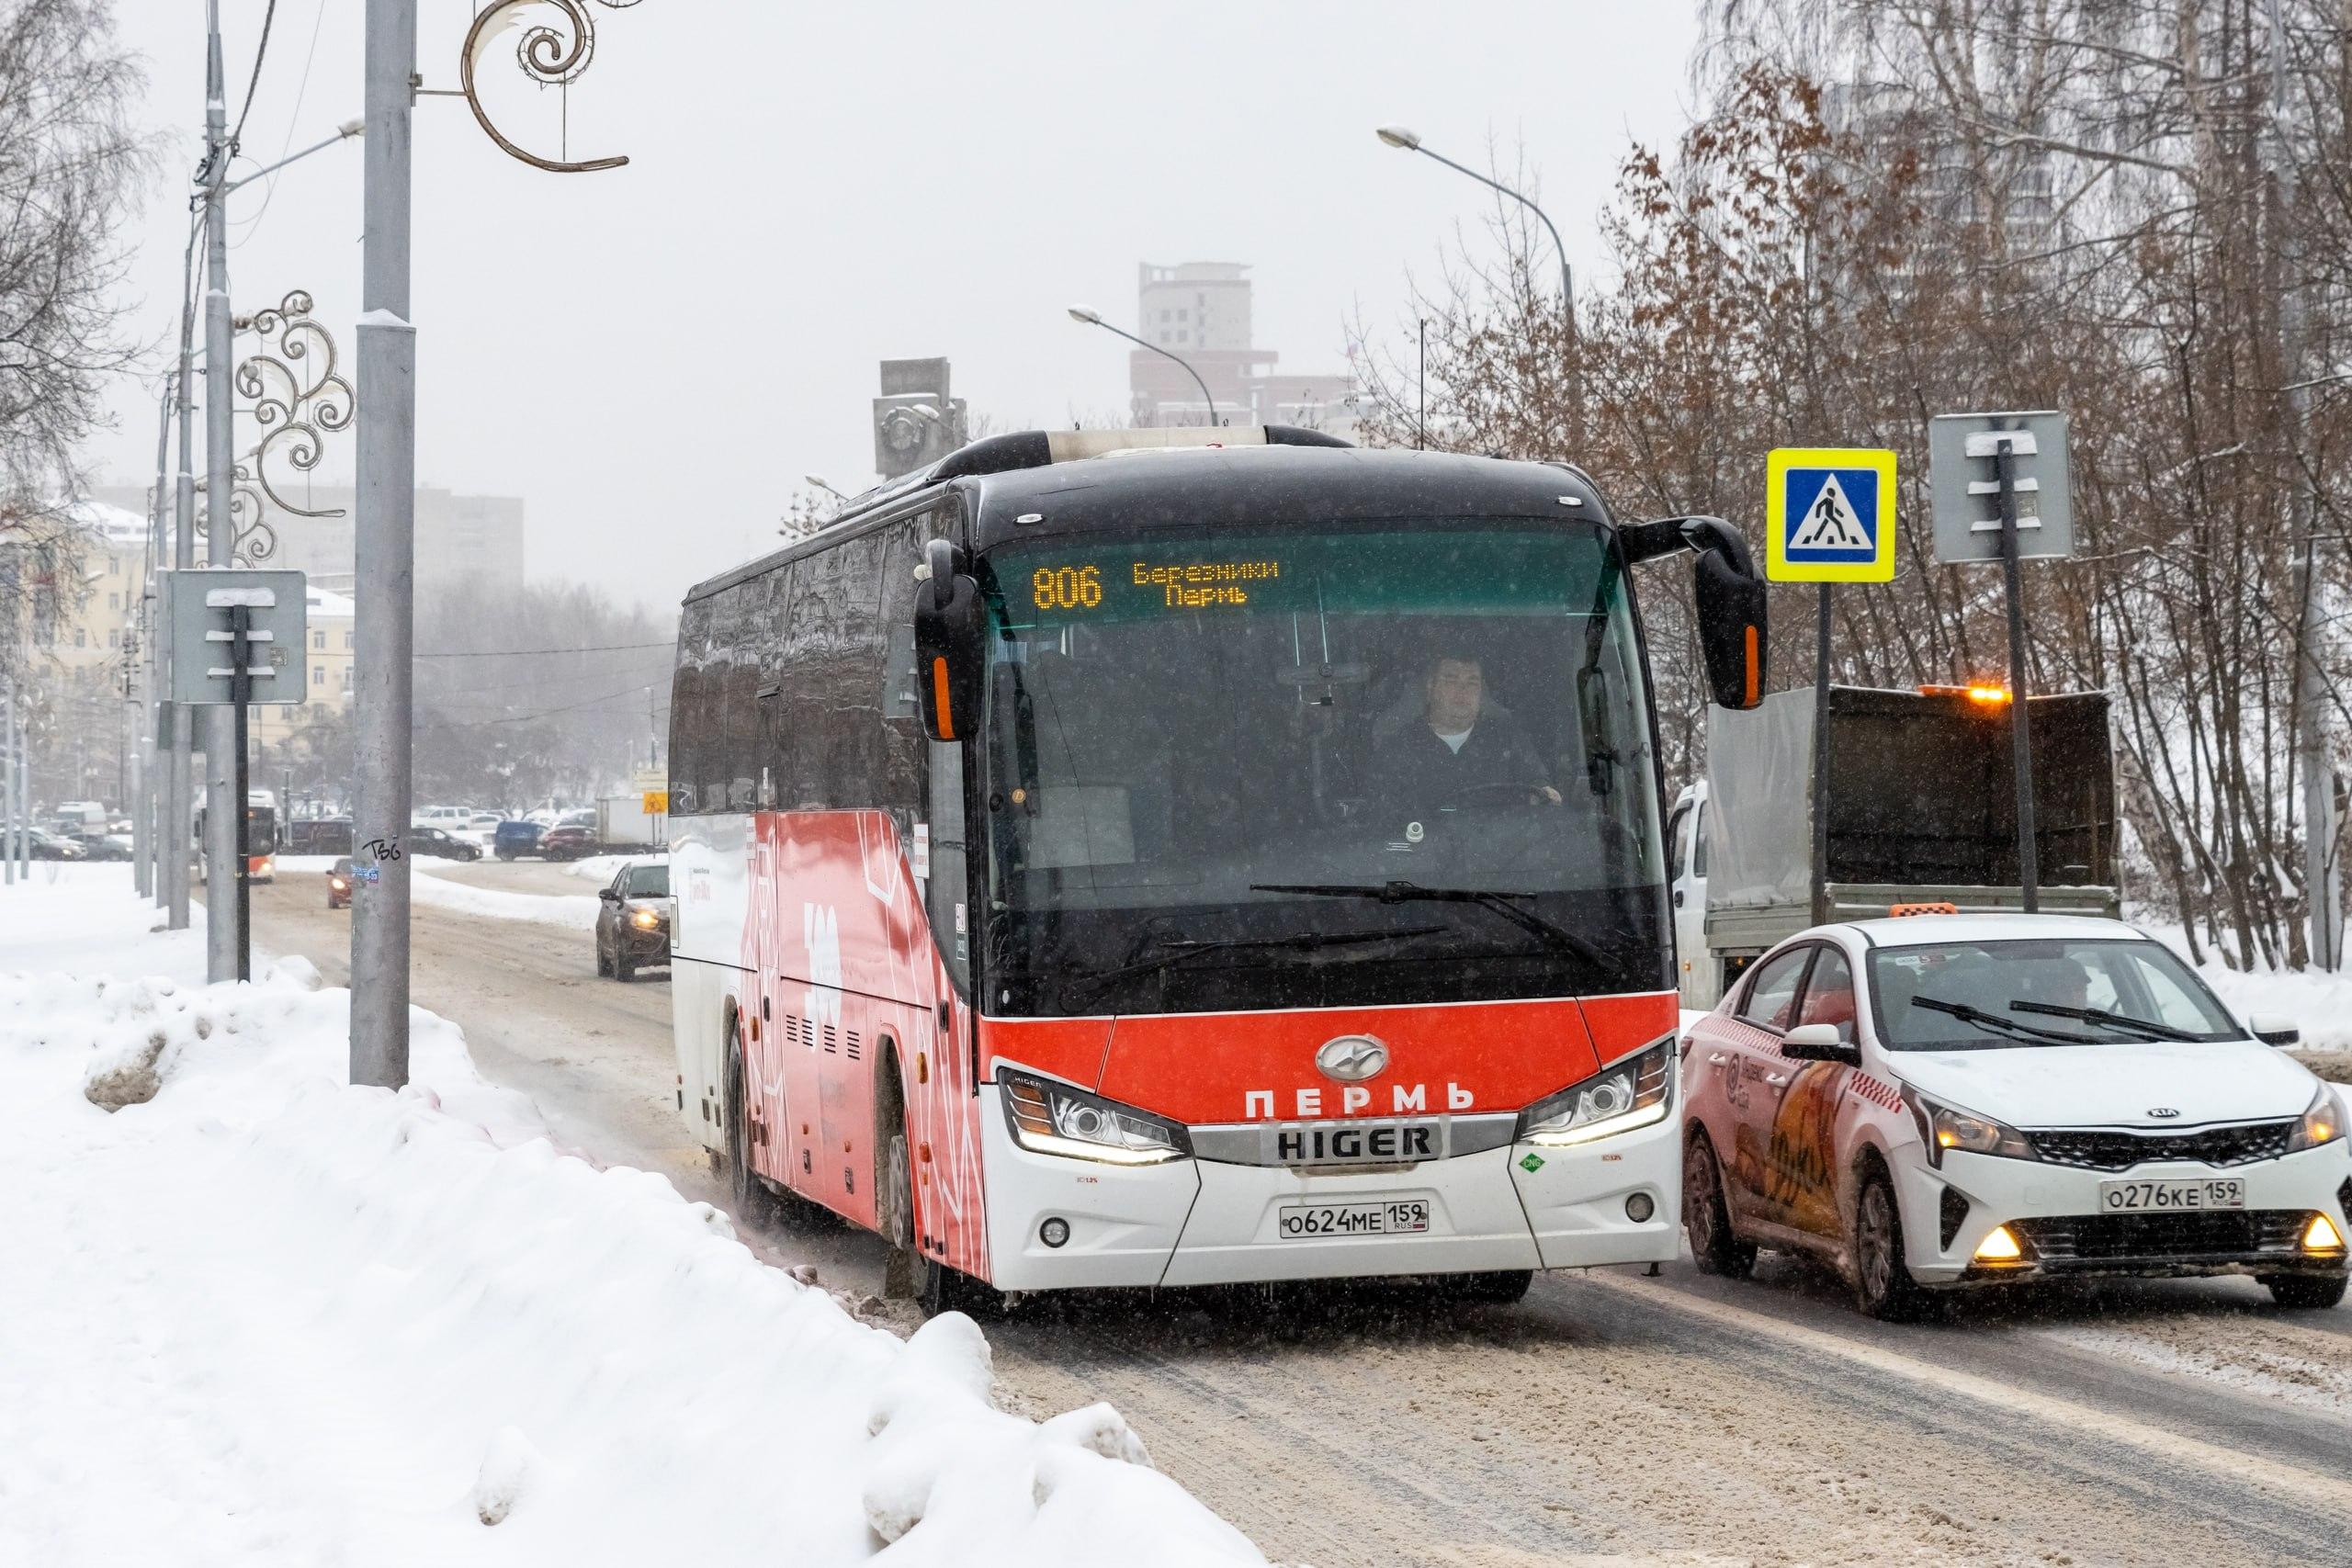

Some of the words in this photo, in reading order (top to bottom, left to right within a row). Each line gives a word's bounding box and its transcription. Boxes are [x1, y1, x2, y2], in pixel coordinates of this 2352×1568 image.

[1132, 561, 1279, 585] Березники
[1033, 566, 1102, 609] 806
[1166, 583, 1248, 607] Пермь
[1245, 1082, 1474, 1118] ПЕРМЬ
[2151, 1109, 2177, 1117] KIA
[1278, 1127, 1431, 1160] HIGER
[2205, 1182, 2237, 1200] 159
[1387, 1203, 1423, 1224] 159
[1395, 1222, 1412, 1230] RUS
